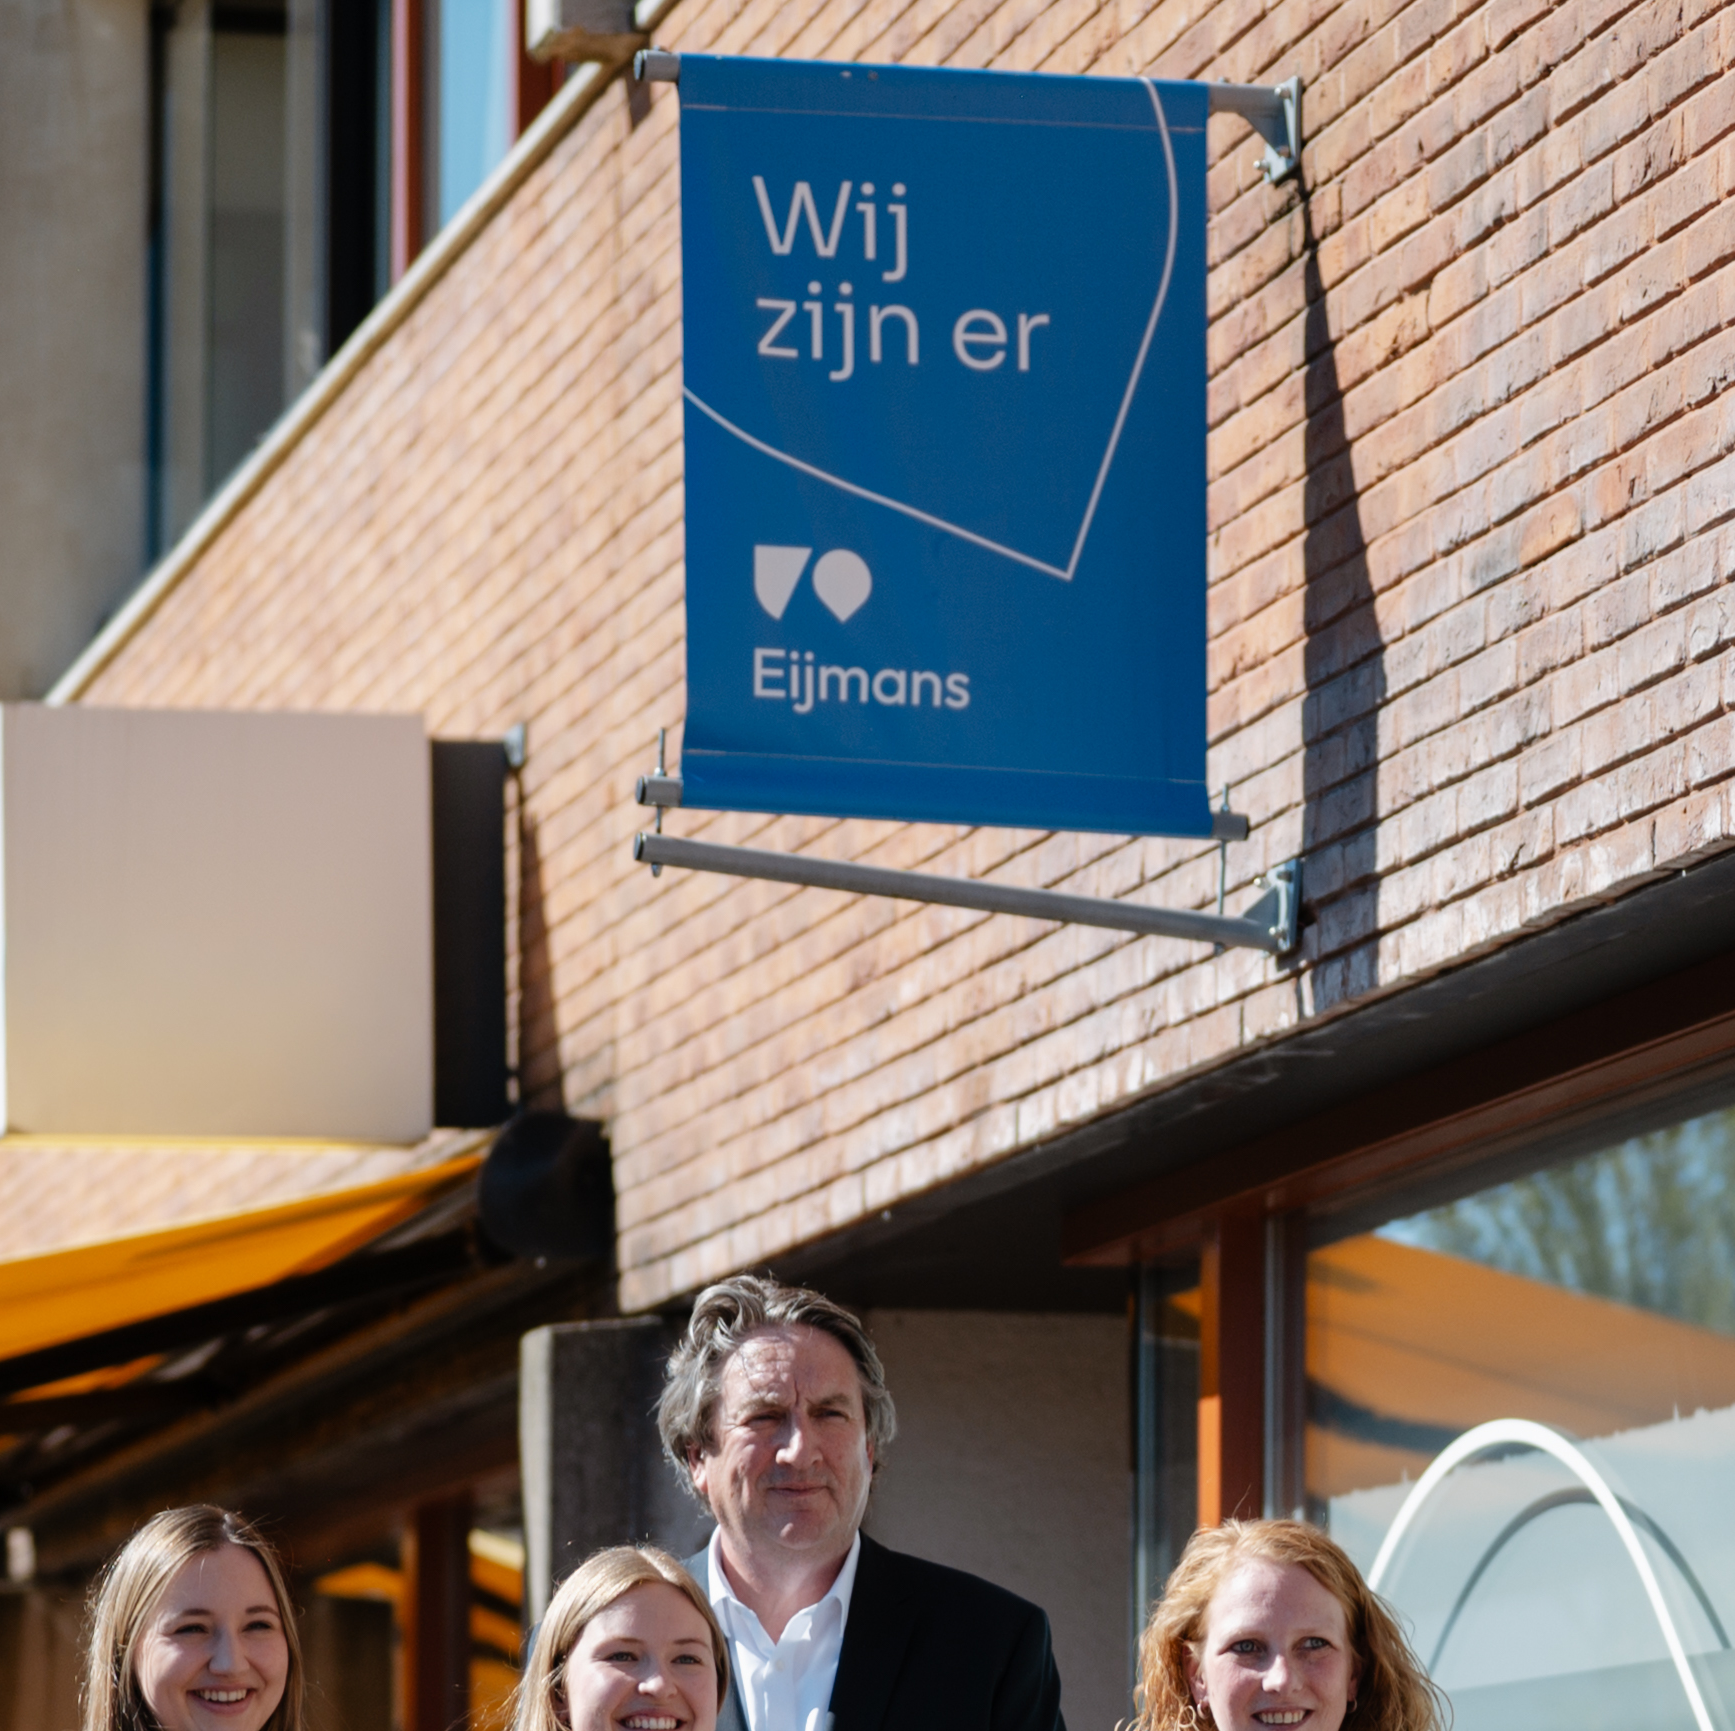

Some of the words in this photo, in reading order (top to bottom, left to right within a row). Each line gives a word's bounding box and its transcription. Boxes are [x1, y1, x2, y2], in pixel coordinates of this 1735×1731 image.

[752, 174, 908, 283] Wij
[755, 281, 920, 382] zijn
[952, 308, 1051, 372] er
[753, 647, 971, 714] Eijmans
